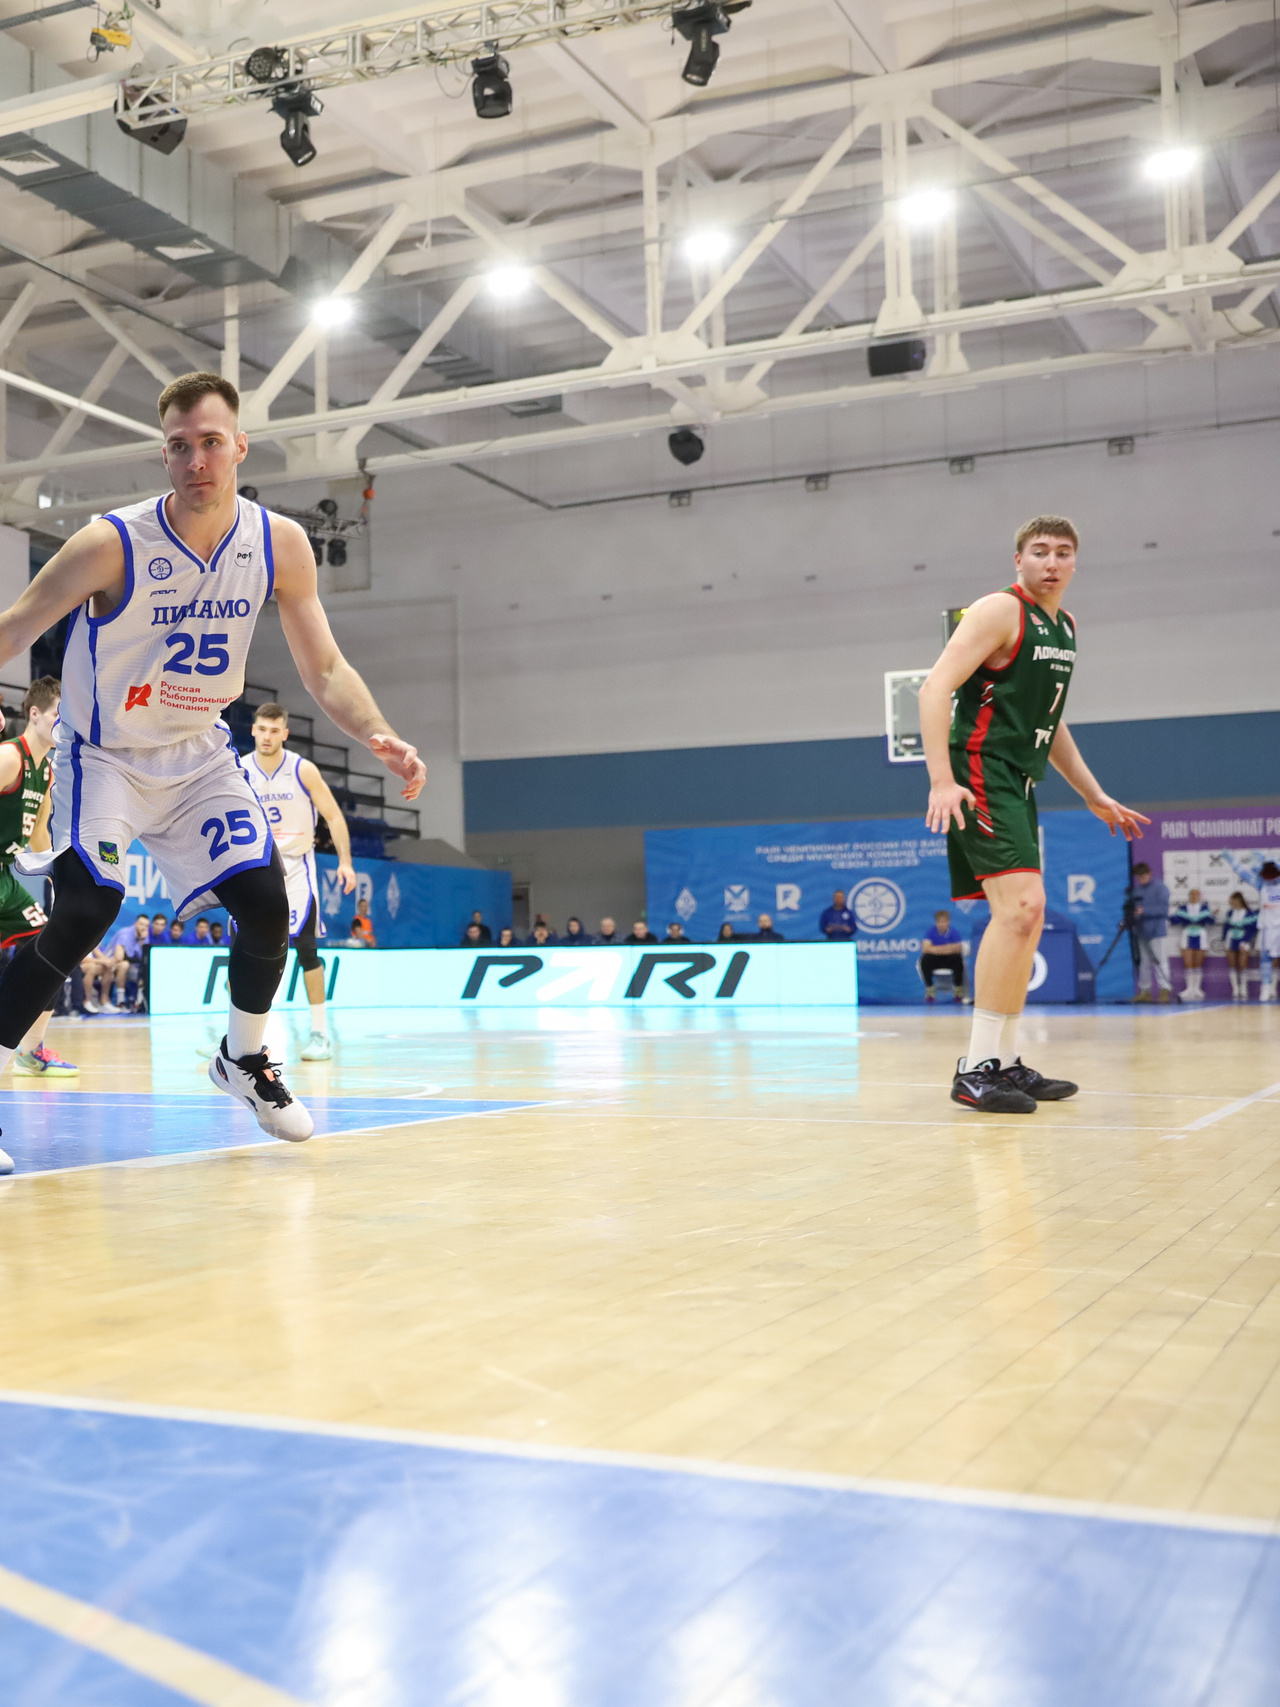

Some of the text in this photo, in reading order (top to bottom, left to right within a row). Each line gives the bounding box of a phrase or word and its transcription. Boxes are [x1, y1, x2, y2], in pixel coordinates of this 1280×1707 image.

[163, 632, 230, 676] 25
[160, 681, 201, 694] Русская
[160, 699, 210, 712] Компания
[1049, 682, 1064, 714] 7
[200, 809, 258, 862] 25
[461, 950, 750, 1001] PARI
